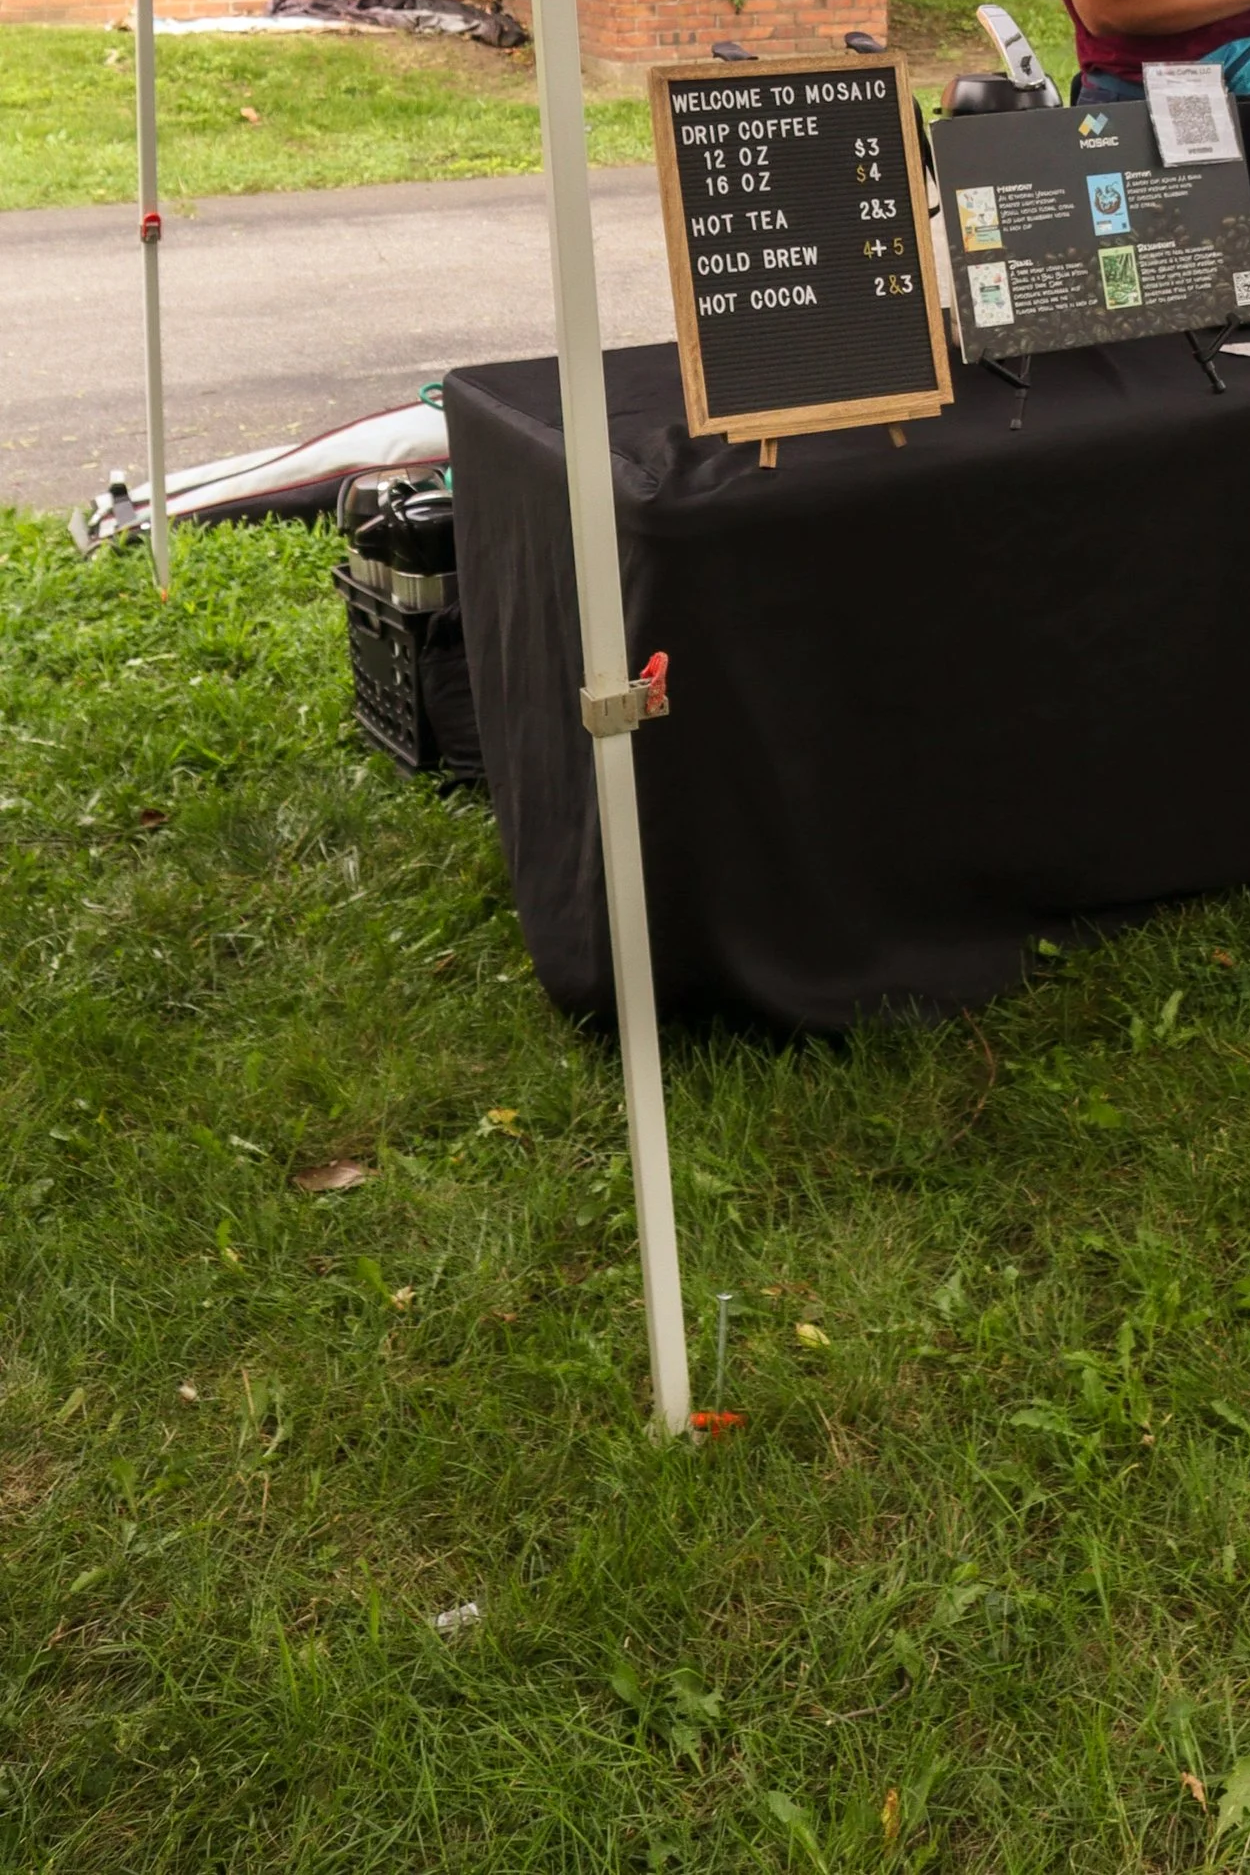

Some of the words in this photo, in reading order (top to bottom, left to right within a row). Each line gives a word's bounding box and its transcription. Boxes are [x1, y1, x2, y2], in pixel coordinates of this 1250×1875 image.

[672, 88, 762, 114] WELCOME
[770, 85, 795, 107] TO
[805, 79, 887, 105] MOSAIC
[681, 123, 730, 145] DRIP
[738, 116, 819, 141] COFFEE
[1079, 136, 1120, 149] MOSAIC
[703, 149, 726, 171] 12
[738, 145, 769, 167] OZ
[854, 137, 880, 158] $3
[706, 175, 729, 197] 16
[741, 171, 771, 192] OZ
[691, 213, 734, 237] HOT
[746, 209, 789, 231] TEA
[859, 199, 897, 221] 2&3
[697, 251, 750, 275] COLD
[762, 245, 819, 269] BREW
[698, 293, 738, 316] HOT
[750, 285, 817, 310] COCOA
